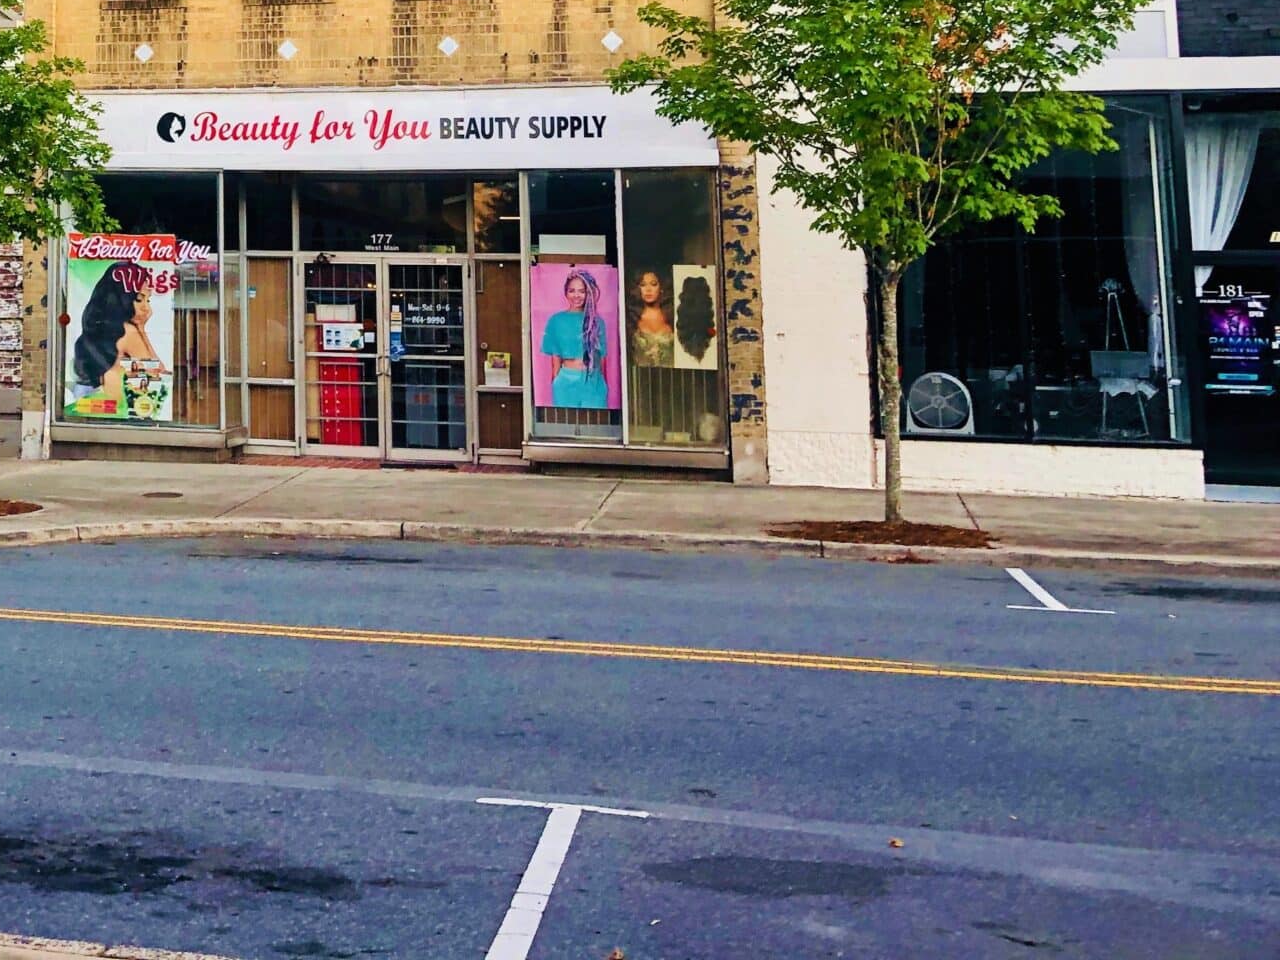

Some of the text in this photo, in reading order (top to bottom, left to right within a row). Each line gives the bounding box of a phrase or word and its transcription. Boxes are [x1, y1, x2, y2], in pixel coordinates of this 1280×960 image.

[190, 109, 607, 151] Beauty for You BEAUTY SUPPLY
[77, 237, 211, 265] Beauty For You
[370, 234, 393, 244] 177
[112, 266, 182, 294] Wigs
[1219, 284, 1244, 297] 181
